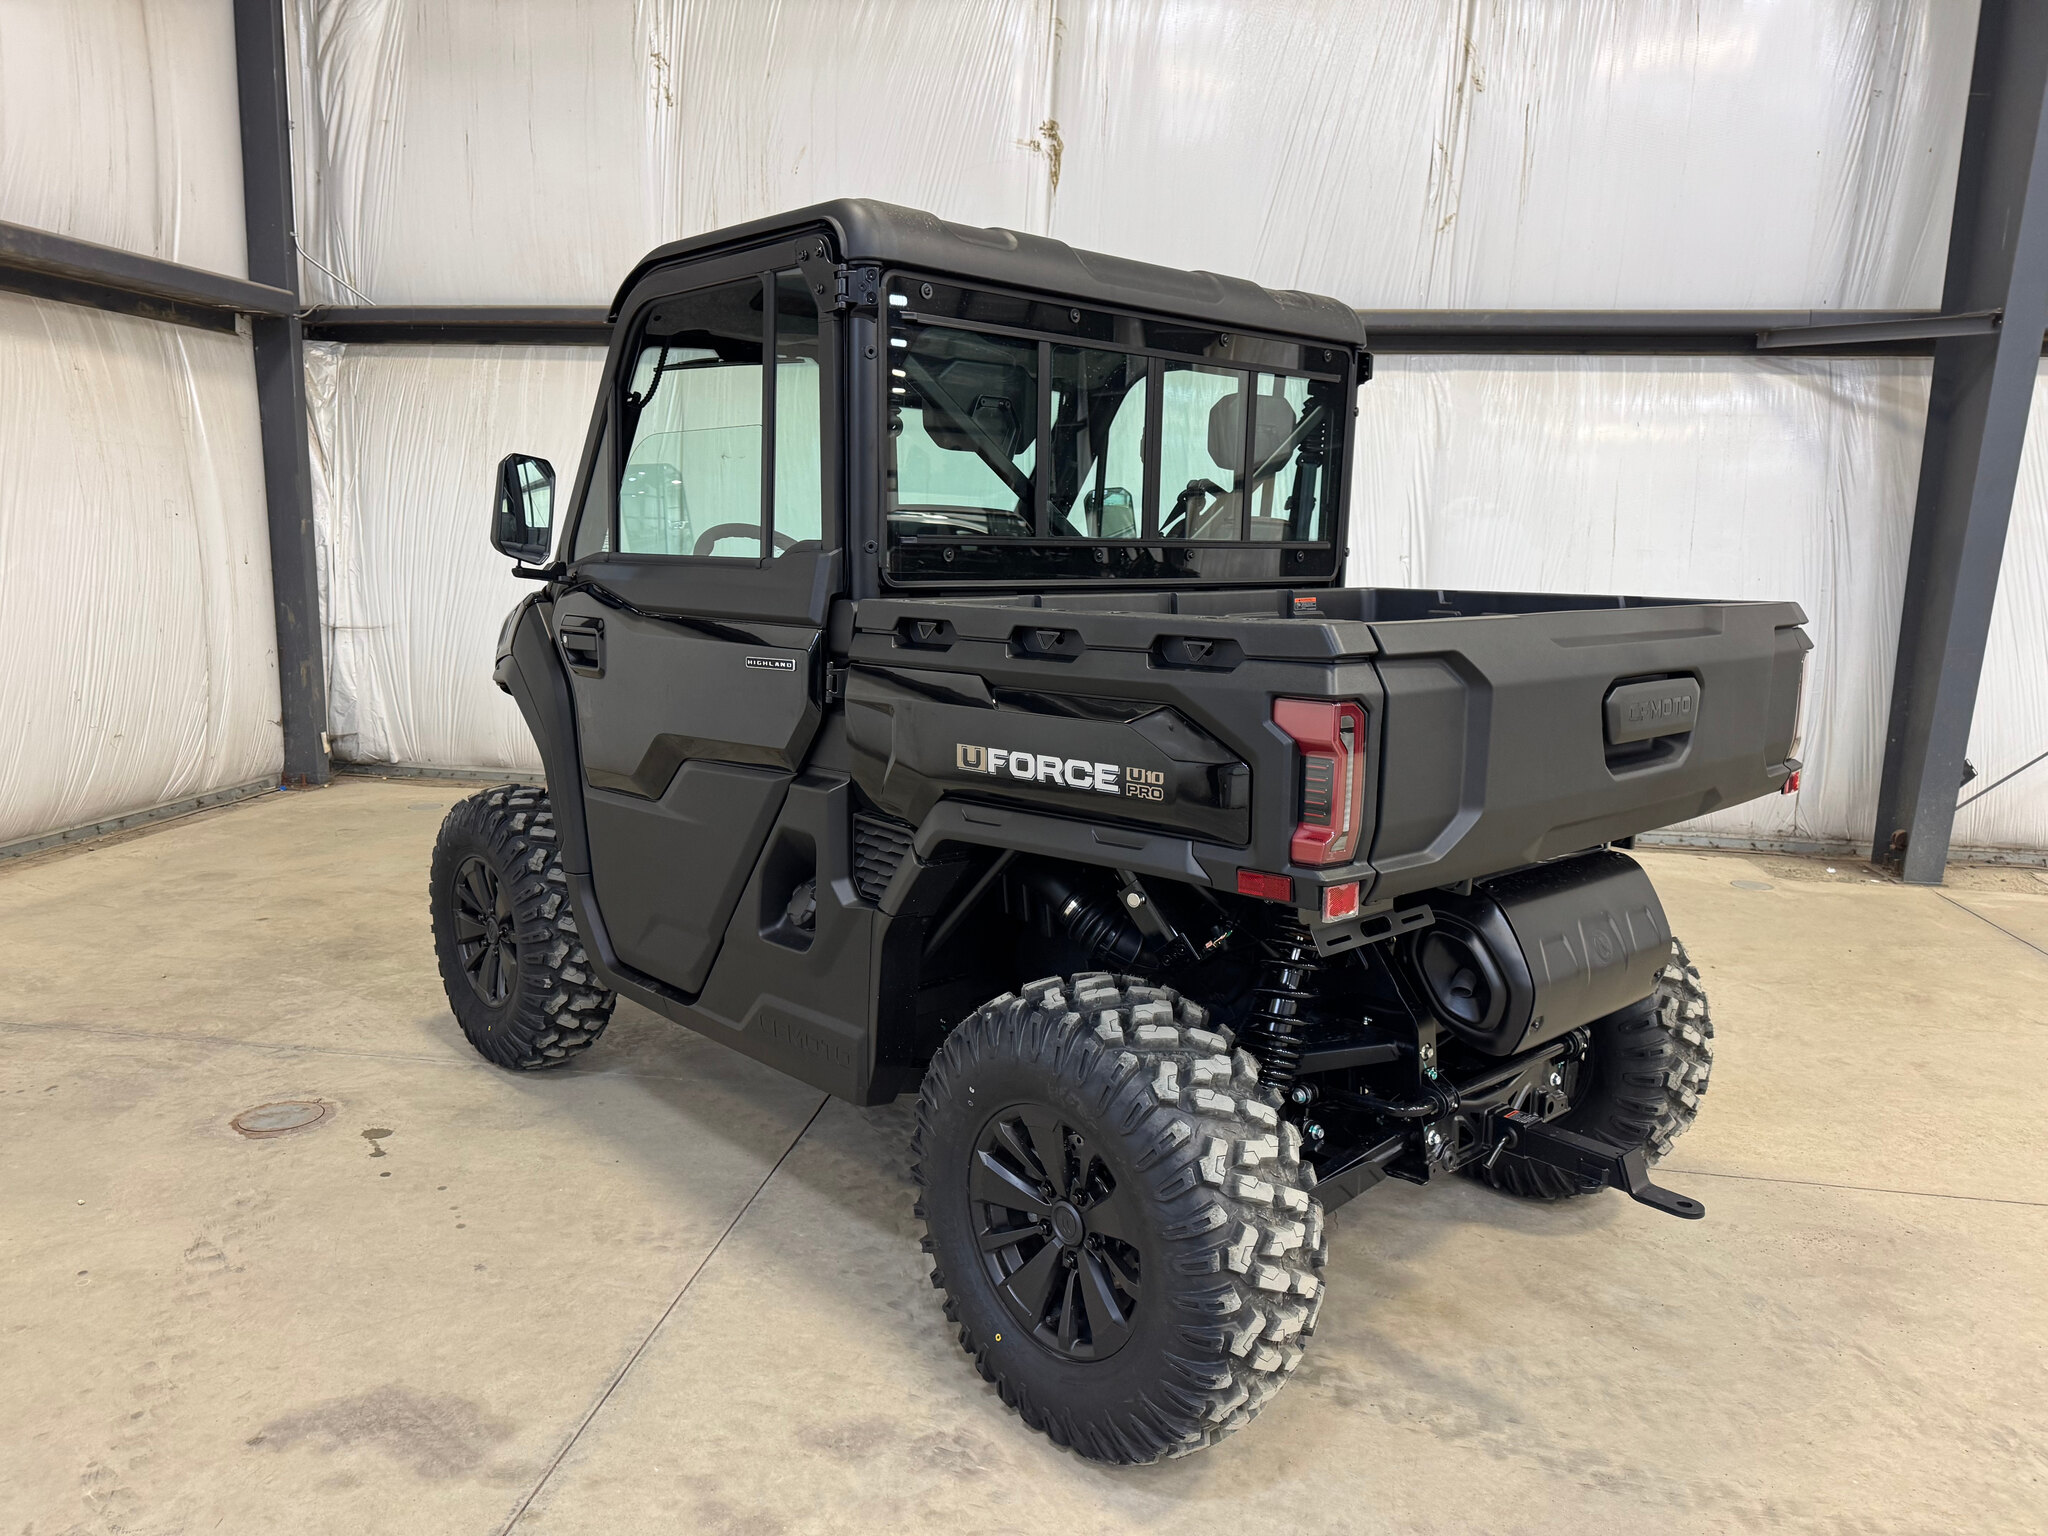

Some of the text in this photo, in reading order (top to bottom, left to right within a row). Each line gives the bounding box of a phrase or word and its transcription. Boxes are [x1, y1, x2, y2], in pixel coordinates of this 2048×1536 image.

[747, 659, 793, 668] HIGHLAND
[957, 743, 1121, 794] UFORCE
[1126, 766, 1164, 785] U10
[1126, 783, 1164, 801] PRO
